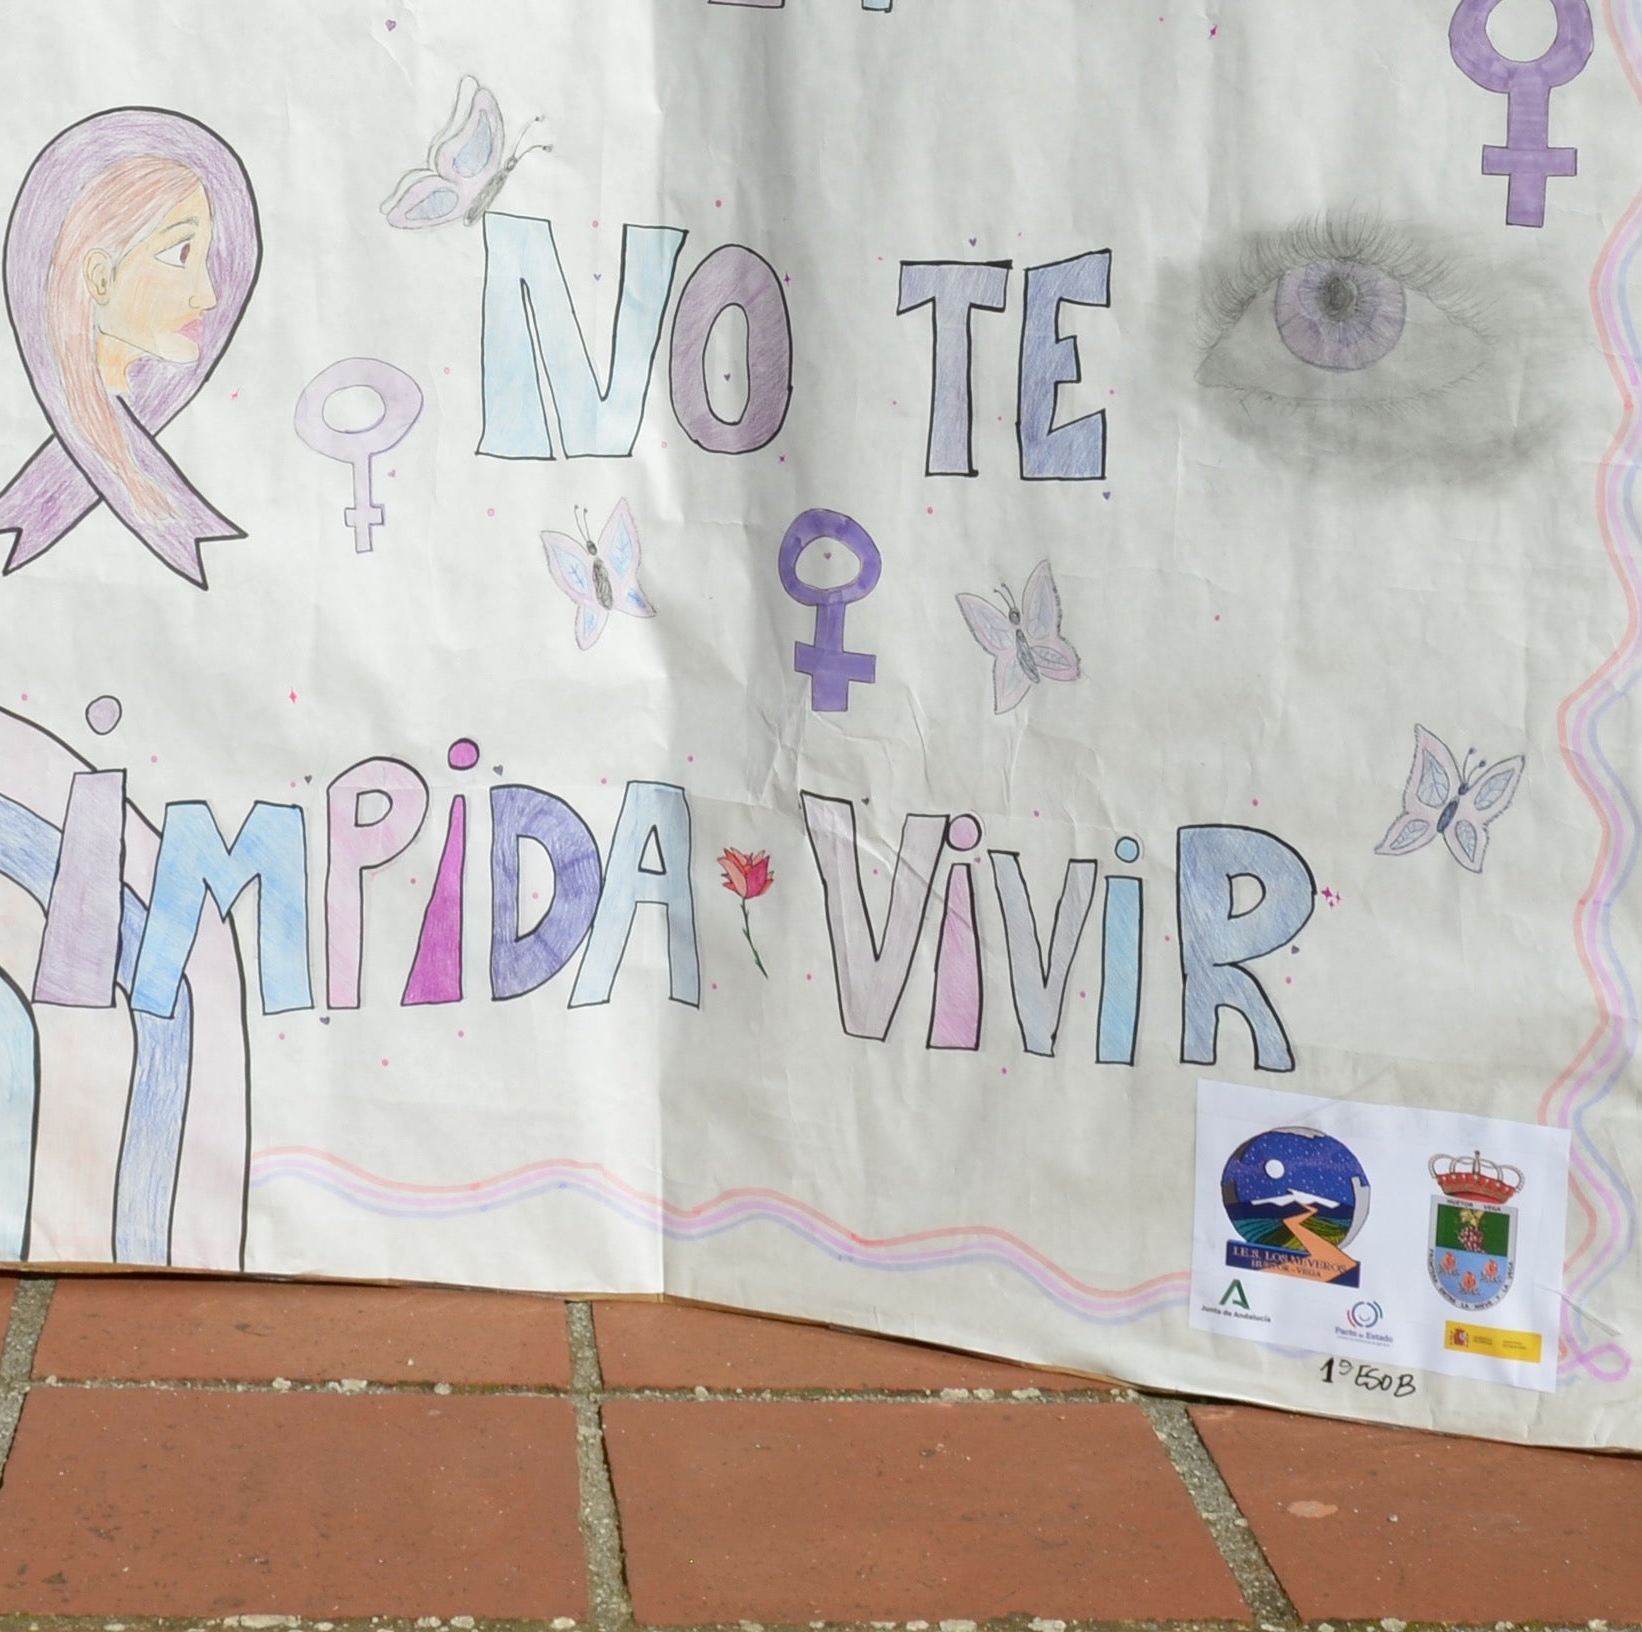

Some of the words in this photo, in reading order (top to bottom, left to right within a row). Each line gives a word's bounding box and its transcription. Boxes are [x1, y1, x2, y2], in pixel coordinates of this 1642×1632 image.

[474, 210, 795, 458] NO
[895, 247, 1114, 482] TE
[1201, 1304, 1222, 1316] Junta
[1223, 1309, 1232, 1317] de
[1234, 1310, 1272, 1323] Andalucía
[1335, 1325, 1357, 1338] Pacto
[1366, 1331, 1393, 1343] Estado
